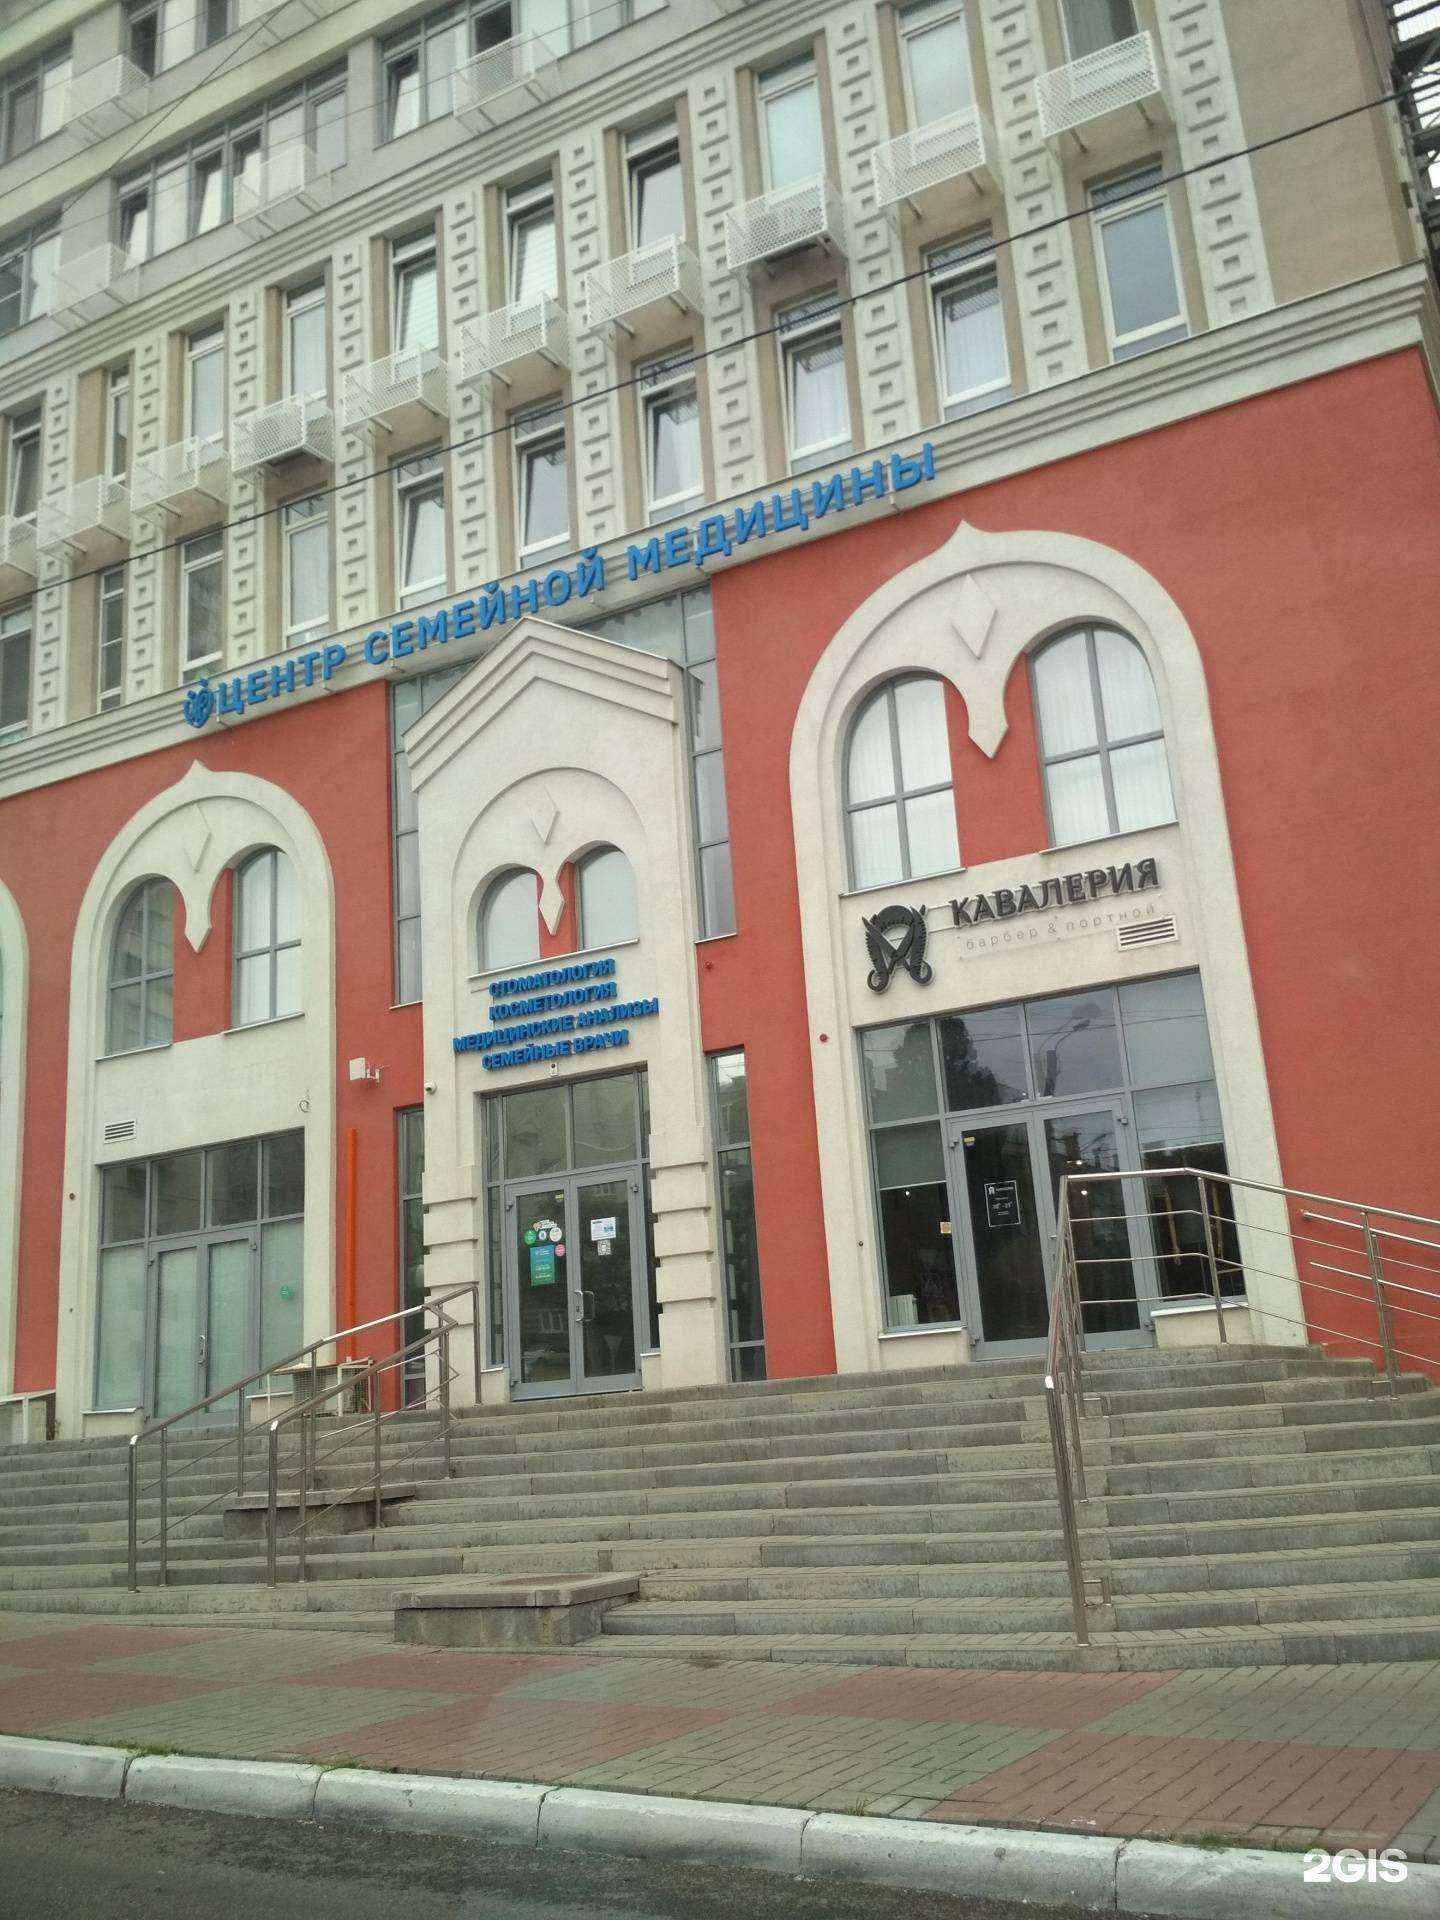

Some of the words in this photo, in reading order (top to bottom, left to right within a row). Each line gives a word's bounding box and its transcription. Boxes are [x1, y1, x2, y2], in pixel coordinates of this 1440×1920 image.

[217, 643, 347, 716] ЦЕНТР
[364, 547, 605, 666] СЕМЕЙНОЙ
[628, 443, 936, 581] МЕДИЦИНЫ
[948, 857, 1159, 928] КАВАЛЕРИЯ
[966, 926, 1038, 951] барбер
[1066, 904, 1156, 932] портной
[489, 958, 616, 997] СТОМАТОЛОГИЯ
[489, 982, 618, 1021] КОСМЕТОЛОГИЯ
[453, 1015, 575, 1054] МЕДИЦИНСКИЕ
[576, 997, 660, 1028] АНАЛИЗЫ
[481, 1039, 571, 1071] СЕМЕЙНЫЕ
[573, 1029, 630, 1053] ВРАЧИ
